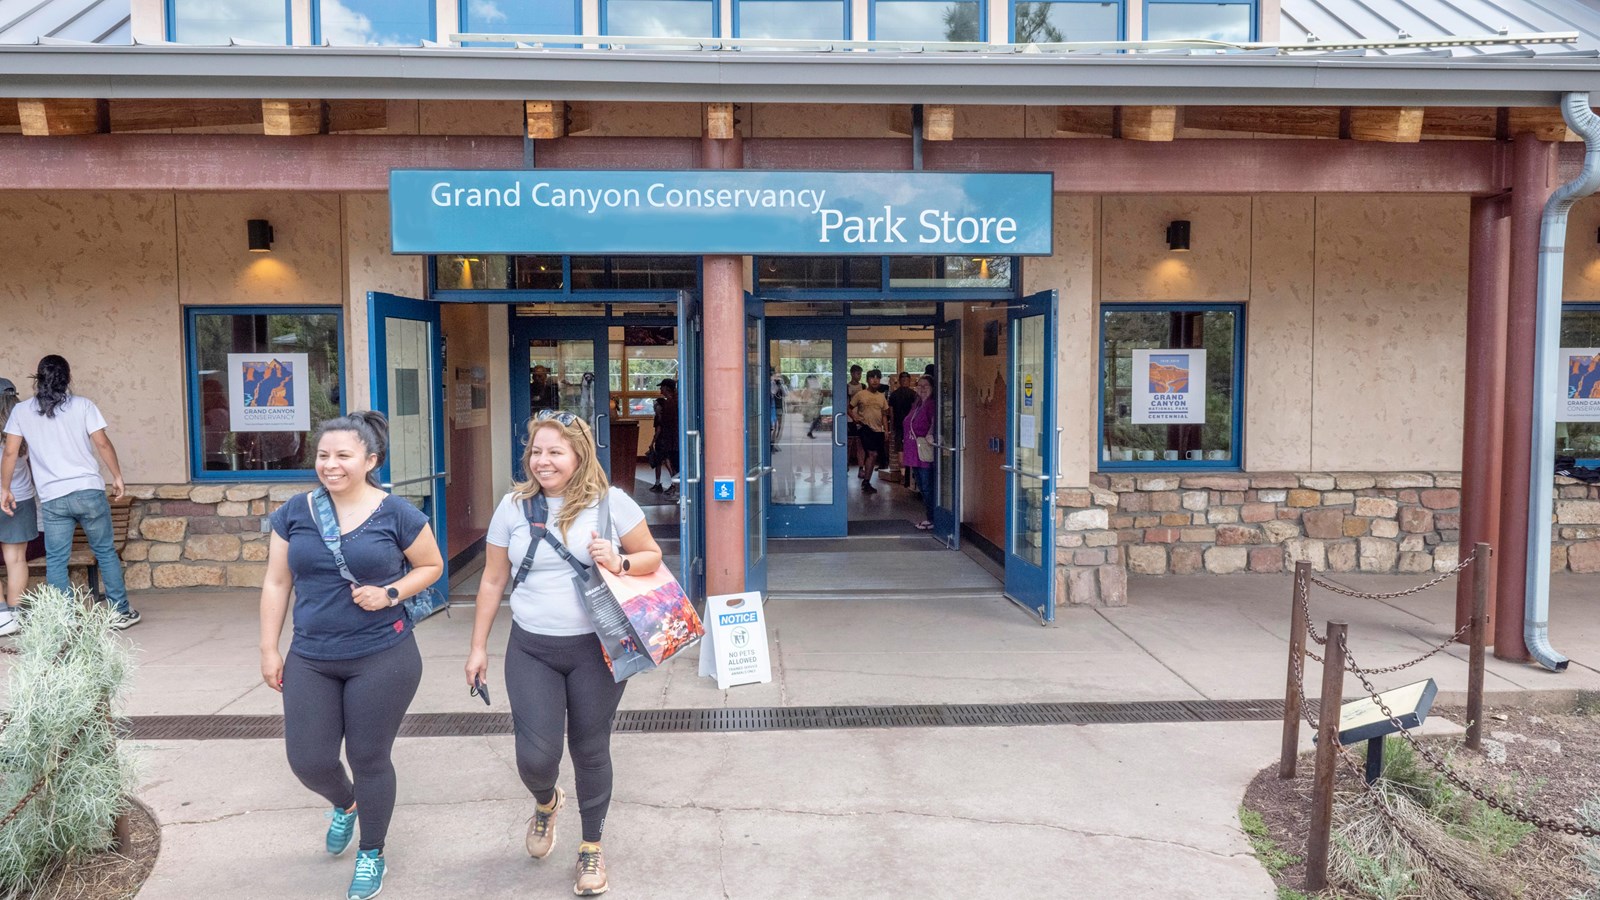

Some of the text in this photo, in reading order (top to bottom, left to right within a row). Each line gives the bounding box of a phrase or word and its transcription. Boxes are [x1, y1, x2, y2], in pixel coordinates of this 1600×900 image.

[431, 181, 826, 214] Grand Canyon Conservancy
[819, 205, 1017, 244] Park Store
[721, 613, 756, 624] NOTICE
[739, 649, 755, 657] PETS
[728, 656, 757, 665] ALLOWED
